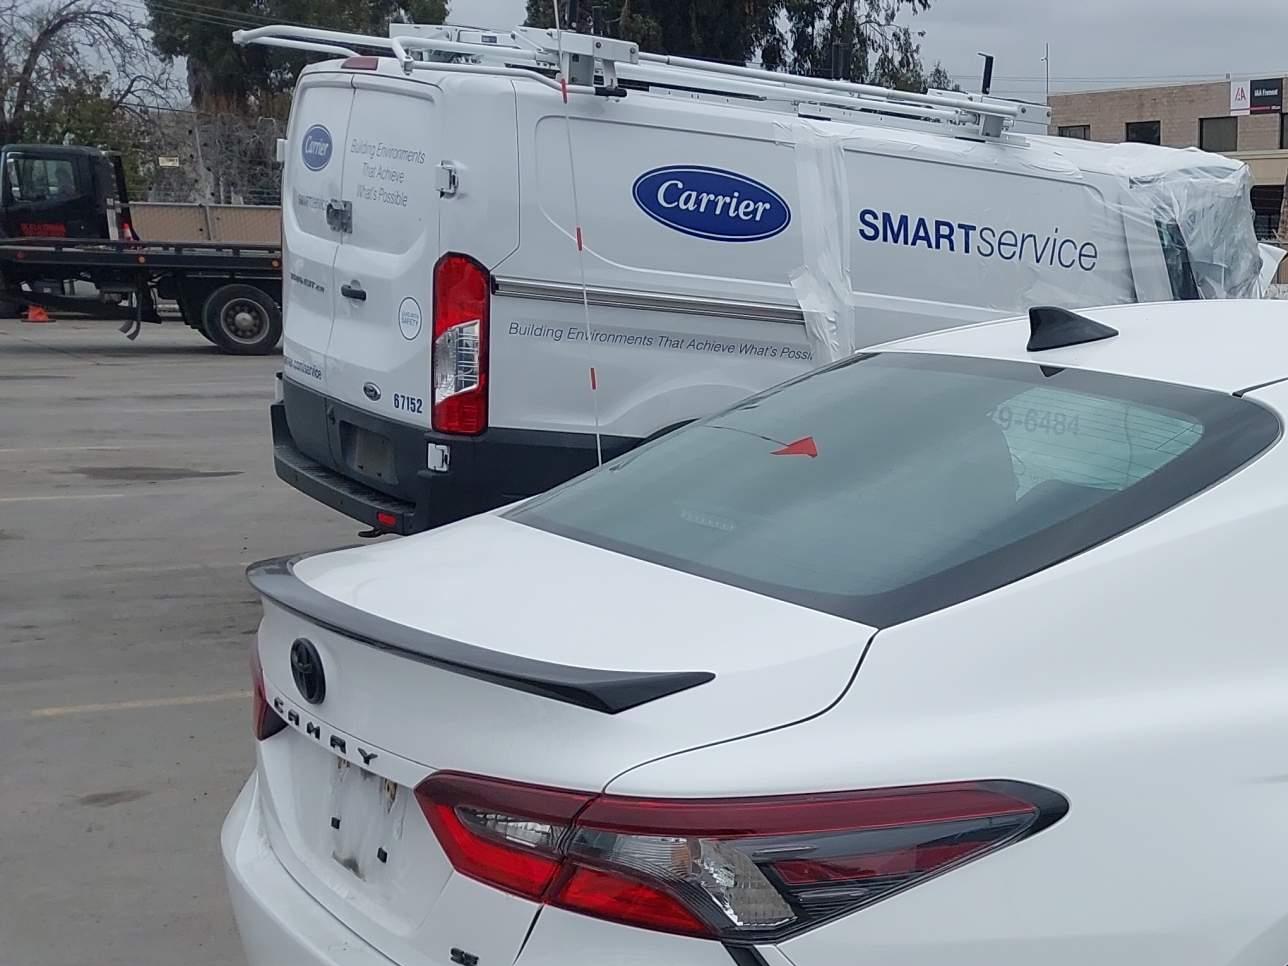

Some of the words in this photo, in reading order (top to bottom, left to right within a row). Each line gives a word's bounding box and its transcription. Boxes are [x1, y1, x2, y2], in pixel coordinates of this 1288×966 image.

[305, 136, 329, 156] Carrier
[351, 139, 376, 159] Building
[376, 142, 426, 164] Environments
[363, 162, 377, 178] That
[377, 165, 405, 183] Achieve
[356, 184, 377, 200] What's
[378, 187, 408, 207] Possible
[656, 179, 771, 222] Carrier
[857, 208, 1099, 272] SMARTservice
[509, 322, 563, 342] Building
[567, 326, 654, 347] Environments
[657, 335, 683, 350] That
[686, 338, 735, 354] Achieve
[738, 343, 777, 357] What's
[393, 393, 423, 414] 67152
[273, 696, 379, 767] CAMRY
